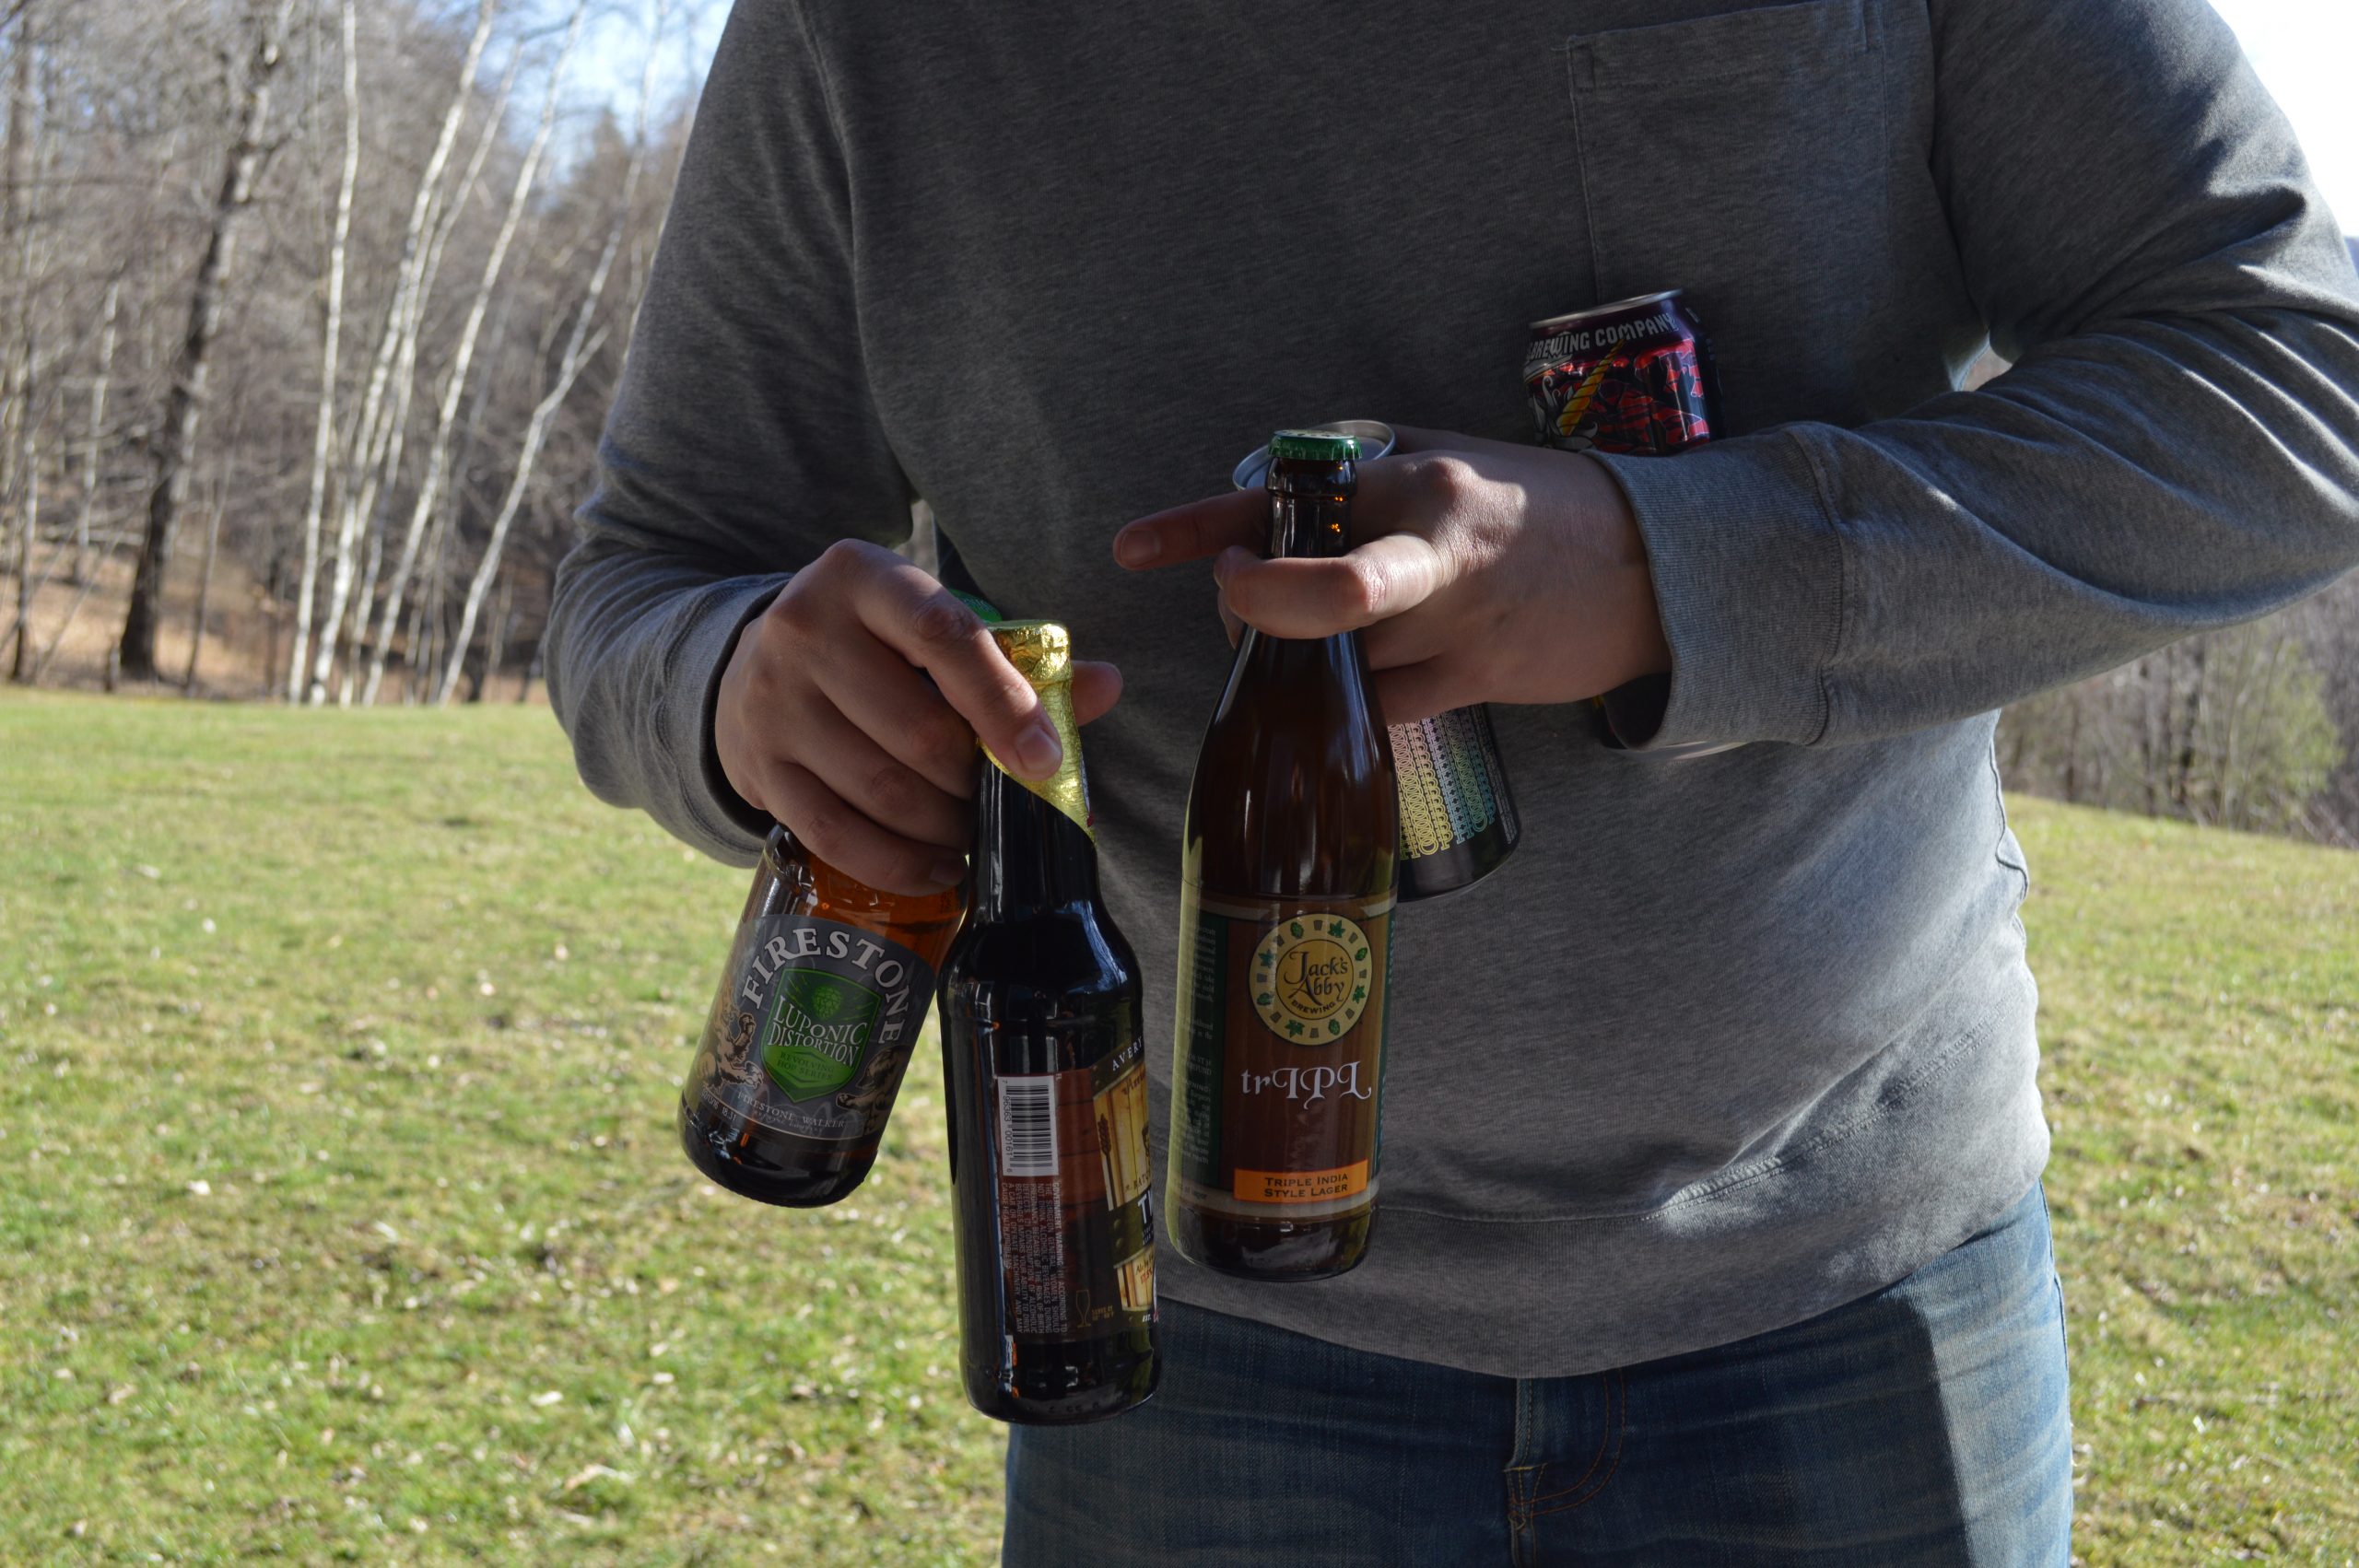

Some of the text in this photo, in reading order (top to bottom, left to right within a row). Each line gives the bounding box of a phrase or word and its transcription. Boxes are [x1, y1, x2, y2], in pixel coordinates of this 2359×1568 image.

[1595, 313, 1676, 346] COMPANY
[1284, 951, 1348, 985] Jack's
[742, 928, 910, 1044] FIRESTONE
[1288, 975, 1344, 1006] Abby
[774, 995, 867, 1045] LUPONIC
[1291, 1000, 1336, 1013] BREWING
[768, 1022, 859, 1067] DISTORTION
[1112, 1036, 1142, 1071] AVERY
[777, 1059, 797, 1071] HOP
[780, 1051, 834, 1072] REVOLVING
[1240, 1061, 1372, 1109] trIPL
[738, 1091, 796, 1121] FIRESTONE
[803, 1116, 845, 1129] WALKER
[1264, 1184, 1348, 1198] STYLE LAGER
[1265, 1173, 1348, 1188] TRIPLE INDIA
